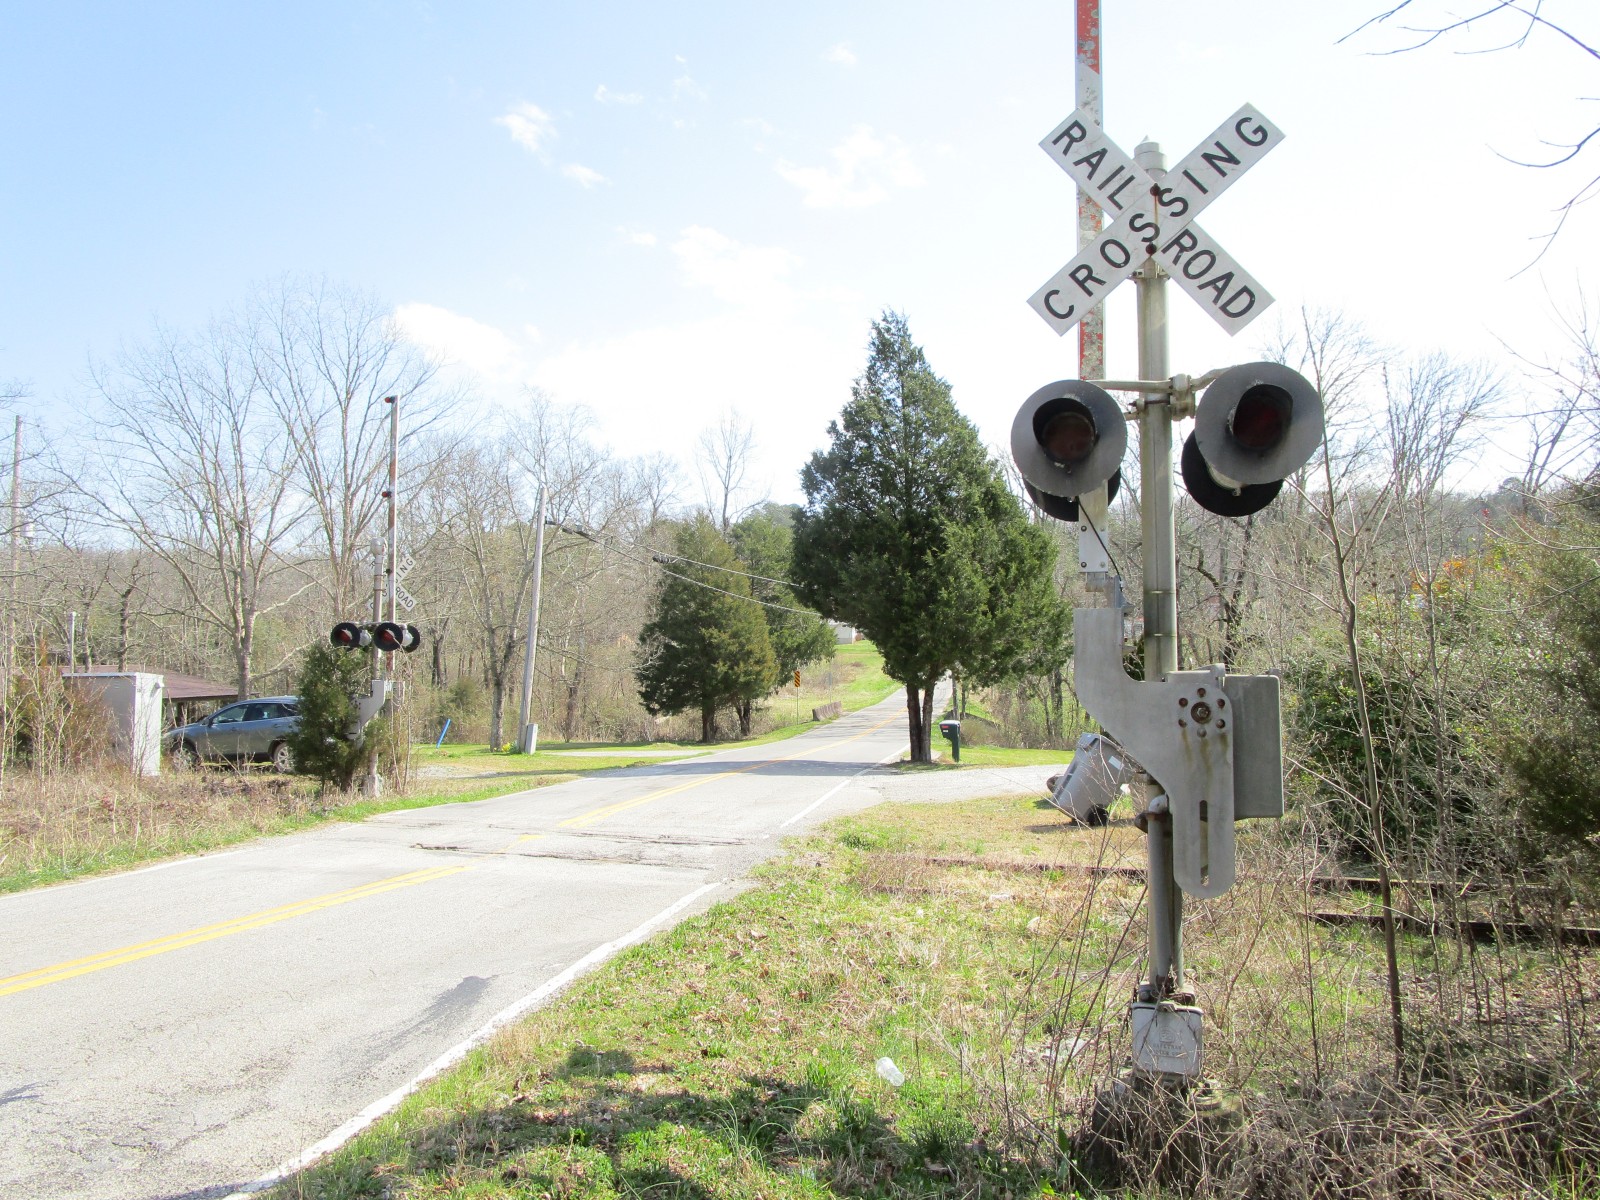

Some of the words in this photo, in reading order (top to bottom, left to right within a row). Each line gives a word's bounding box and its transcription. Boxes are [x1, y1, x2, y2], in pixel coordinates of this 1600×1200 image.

[1043, 117, 1268, 320] CROSSING
[1052, 120, 1135, 211] RAIL
[1161, 228, 1256, 318] ROAD
